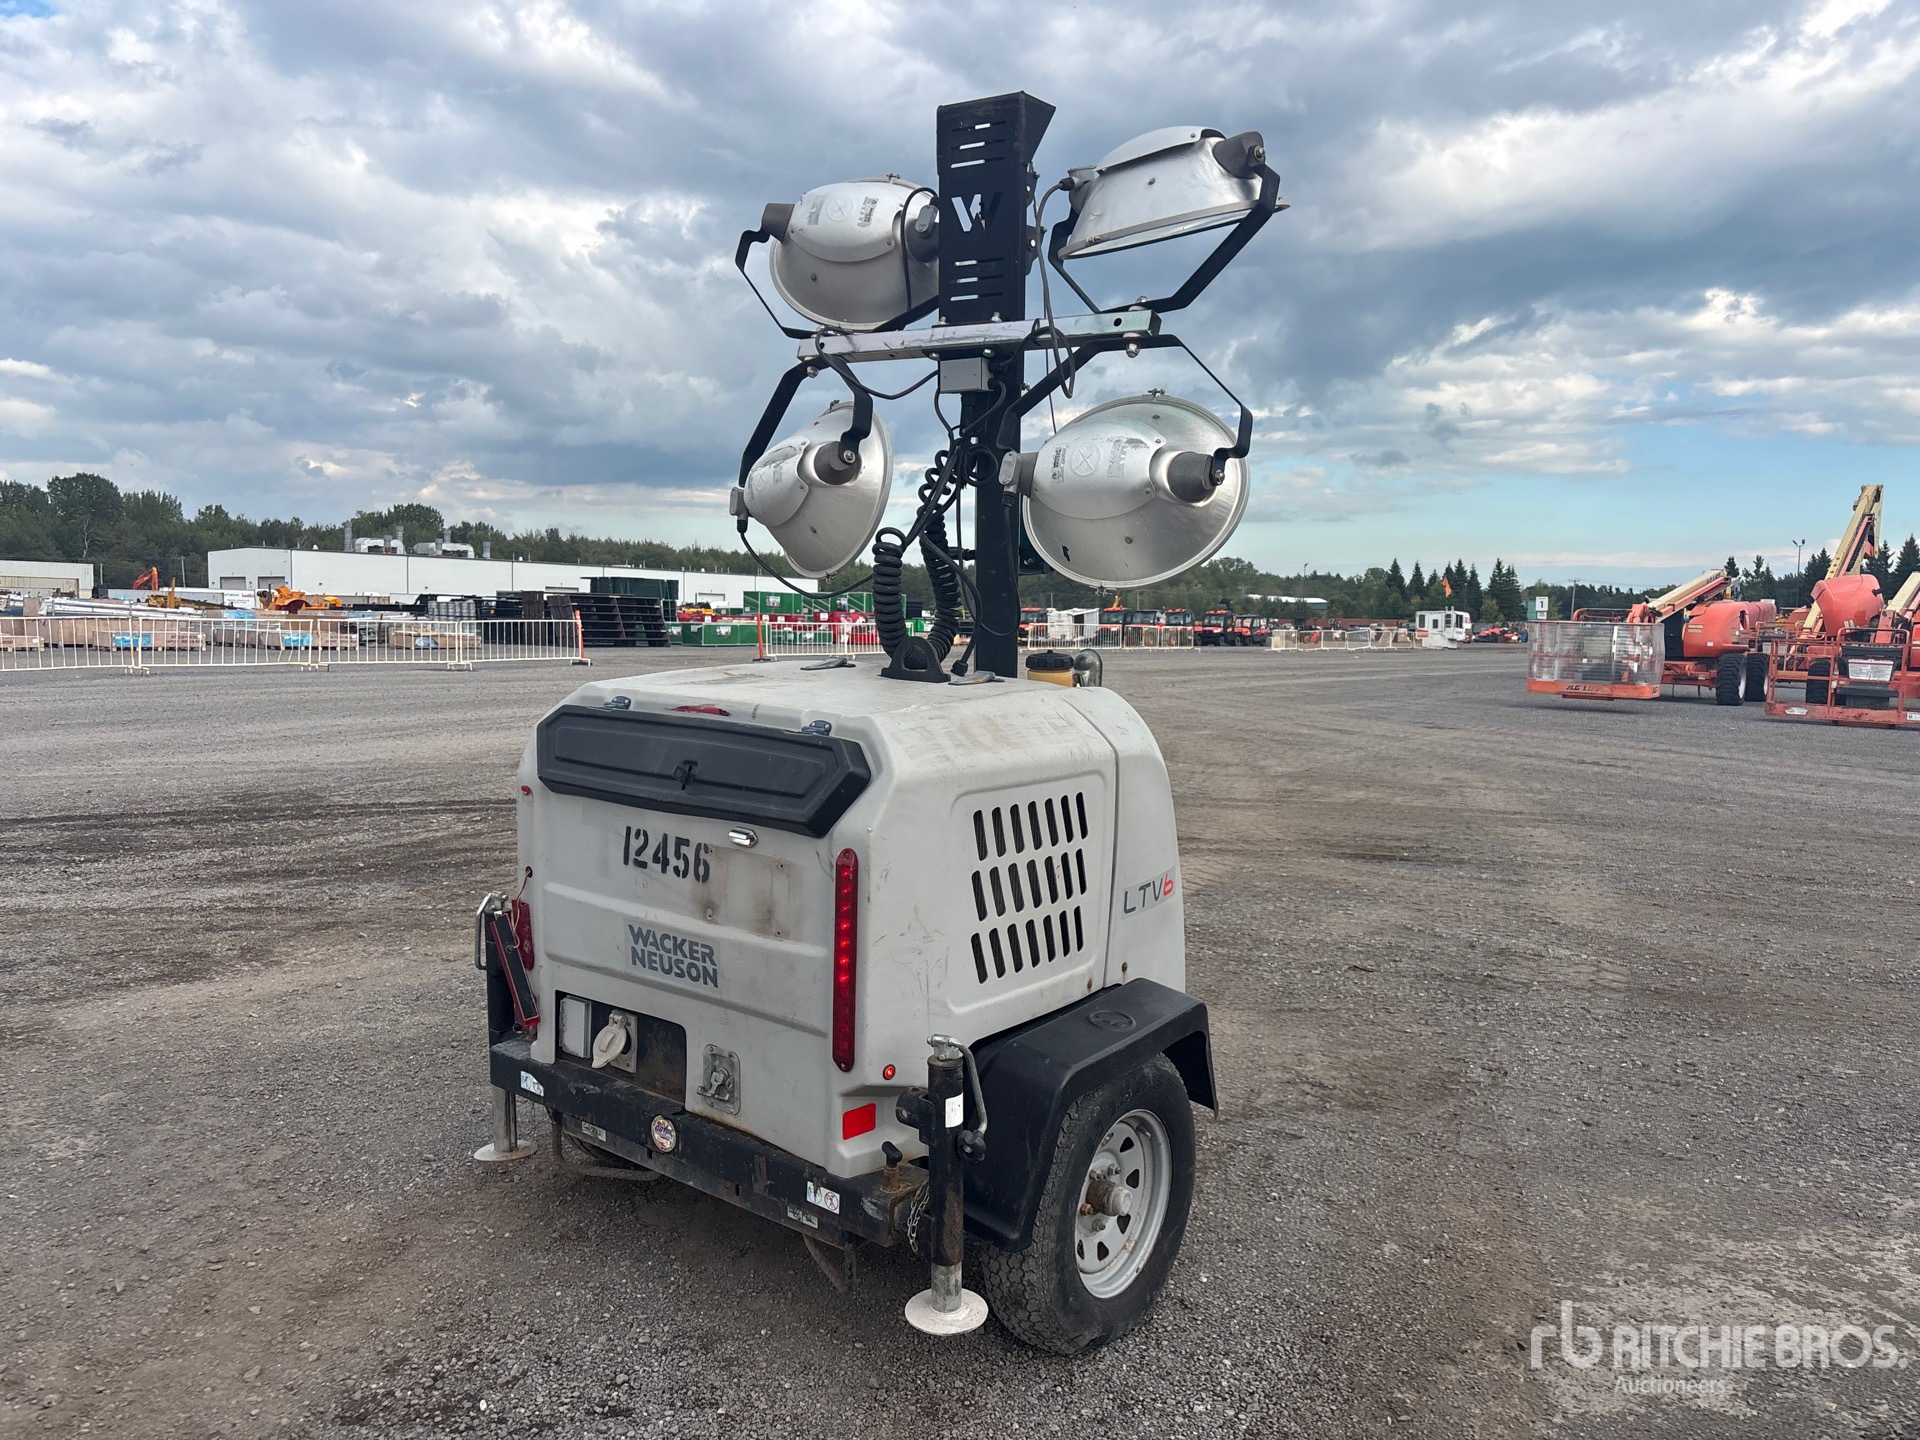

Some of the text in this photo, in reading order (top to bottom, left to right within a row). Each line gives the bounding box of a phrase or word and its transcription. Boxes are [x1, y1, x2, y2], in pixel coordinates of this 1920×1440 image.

[623, 825, 710, 884] 12456
[627, 924, 717, 967] WACKER
[630, 947, 719, 989] NEUSON
